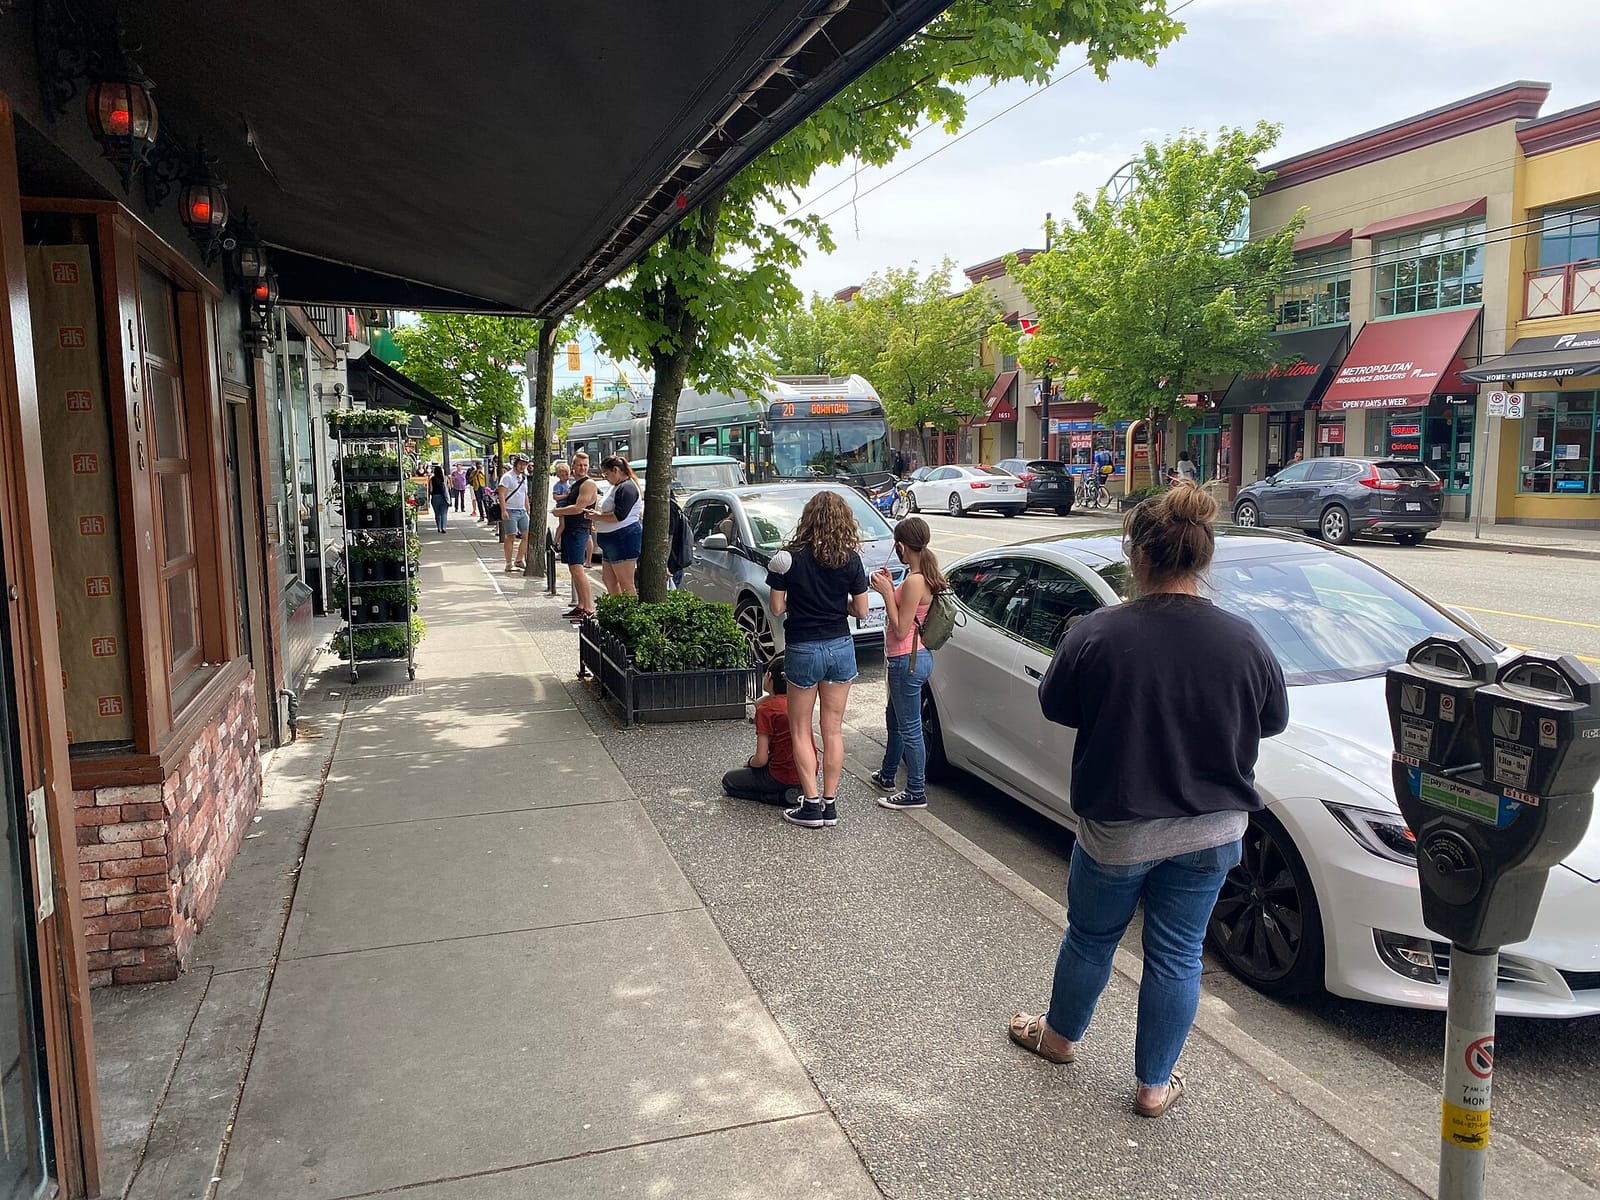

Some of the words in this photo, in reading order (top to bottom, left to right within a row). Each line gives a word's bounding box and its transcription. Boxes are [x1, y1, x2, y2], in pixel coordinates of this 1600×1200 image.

[1340, 362, 1414, 376] METROPOLITAN
[1511, 371, 1548, 379] BUSINESS
[1553, 368, 1574, 376] AUTO
[1335, 375, 1374, 384] INSURANCE
[1372, 372, 1407, 382] BROKERS
[782, 403, 795, 416] 20
[811, 402, 849, 414] DOWNTOWN
[1342, 400, 1359, 409] OPEN
[1365, 399, 1381, 407] DAYS
[1388, 398, 1408, 406] WEEK
[1463, 1096, 1485, 1105] MON
